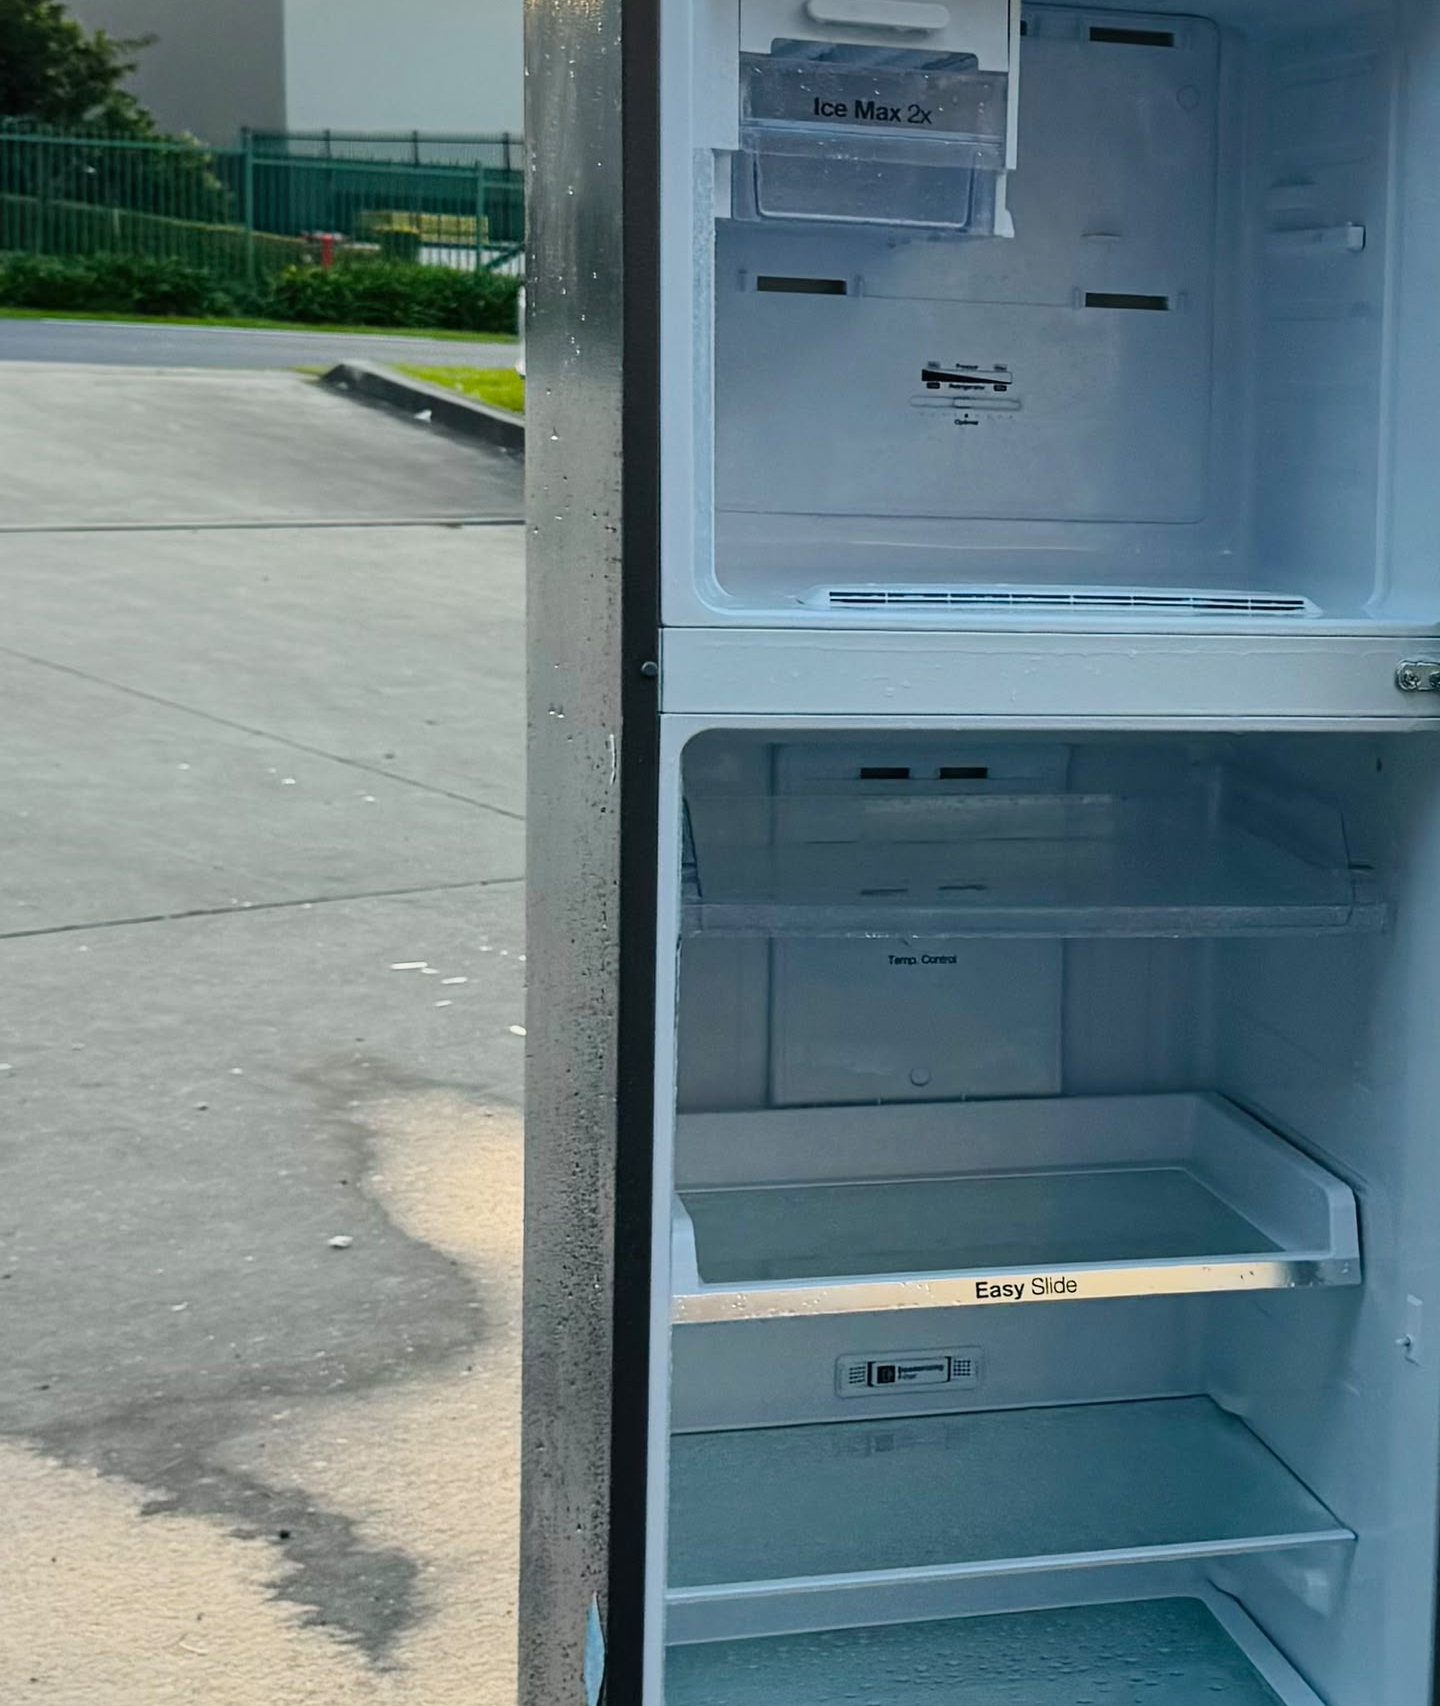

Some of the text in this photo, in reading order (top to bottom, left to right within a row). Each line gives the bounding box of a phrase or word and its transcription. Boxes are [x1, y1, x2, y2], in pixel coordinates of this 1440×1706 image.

[813, 96, 933, 125] Ice Max 2x
[920, 954, 958, 965] Control
[975, 1276, 1078, 1300] Easy Slide
